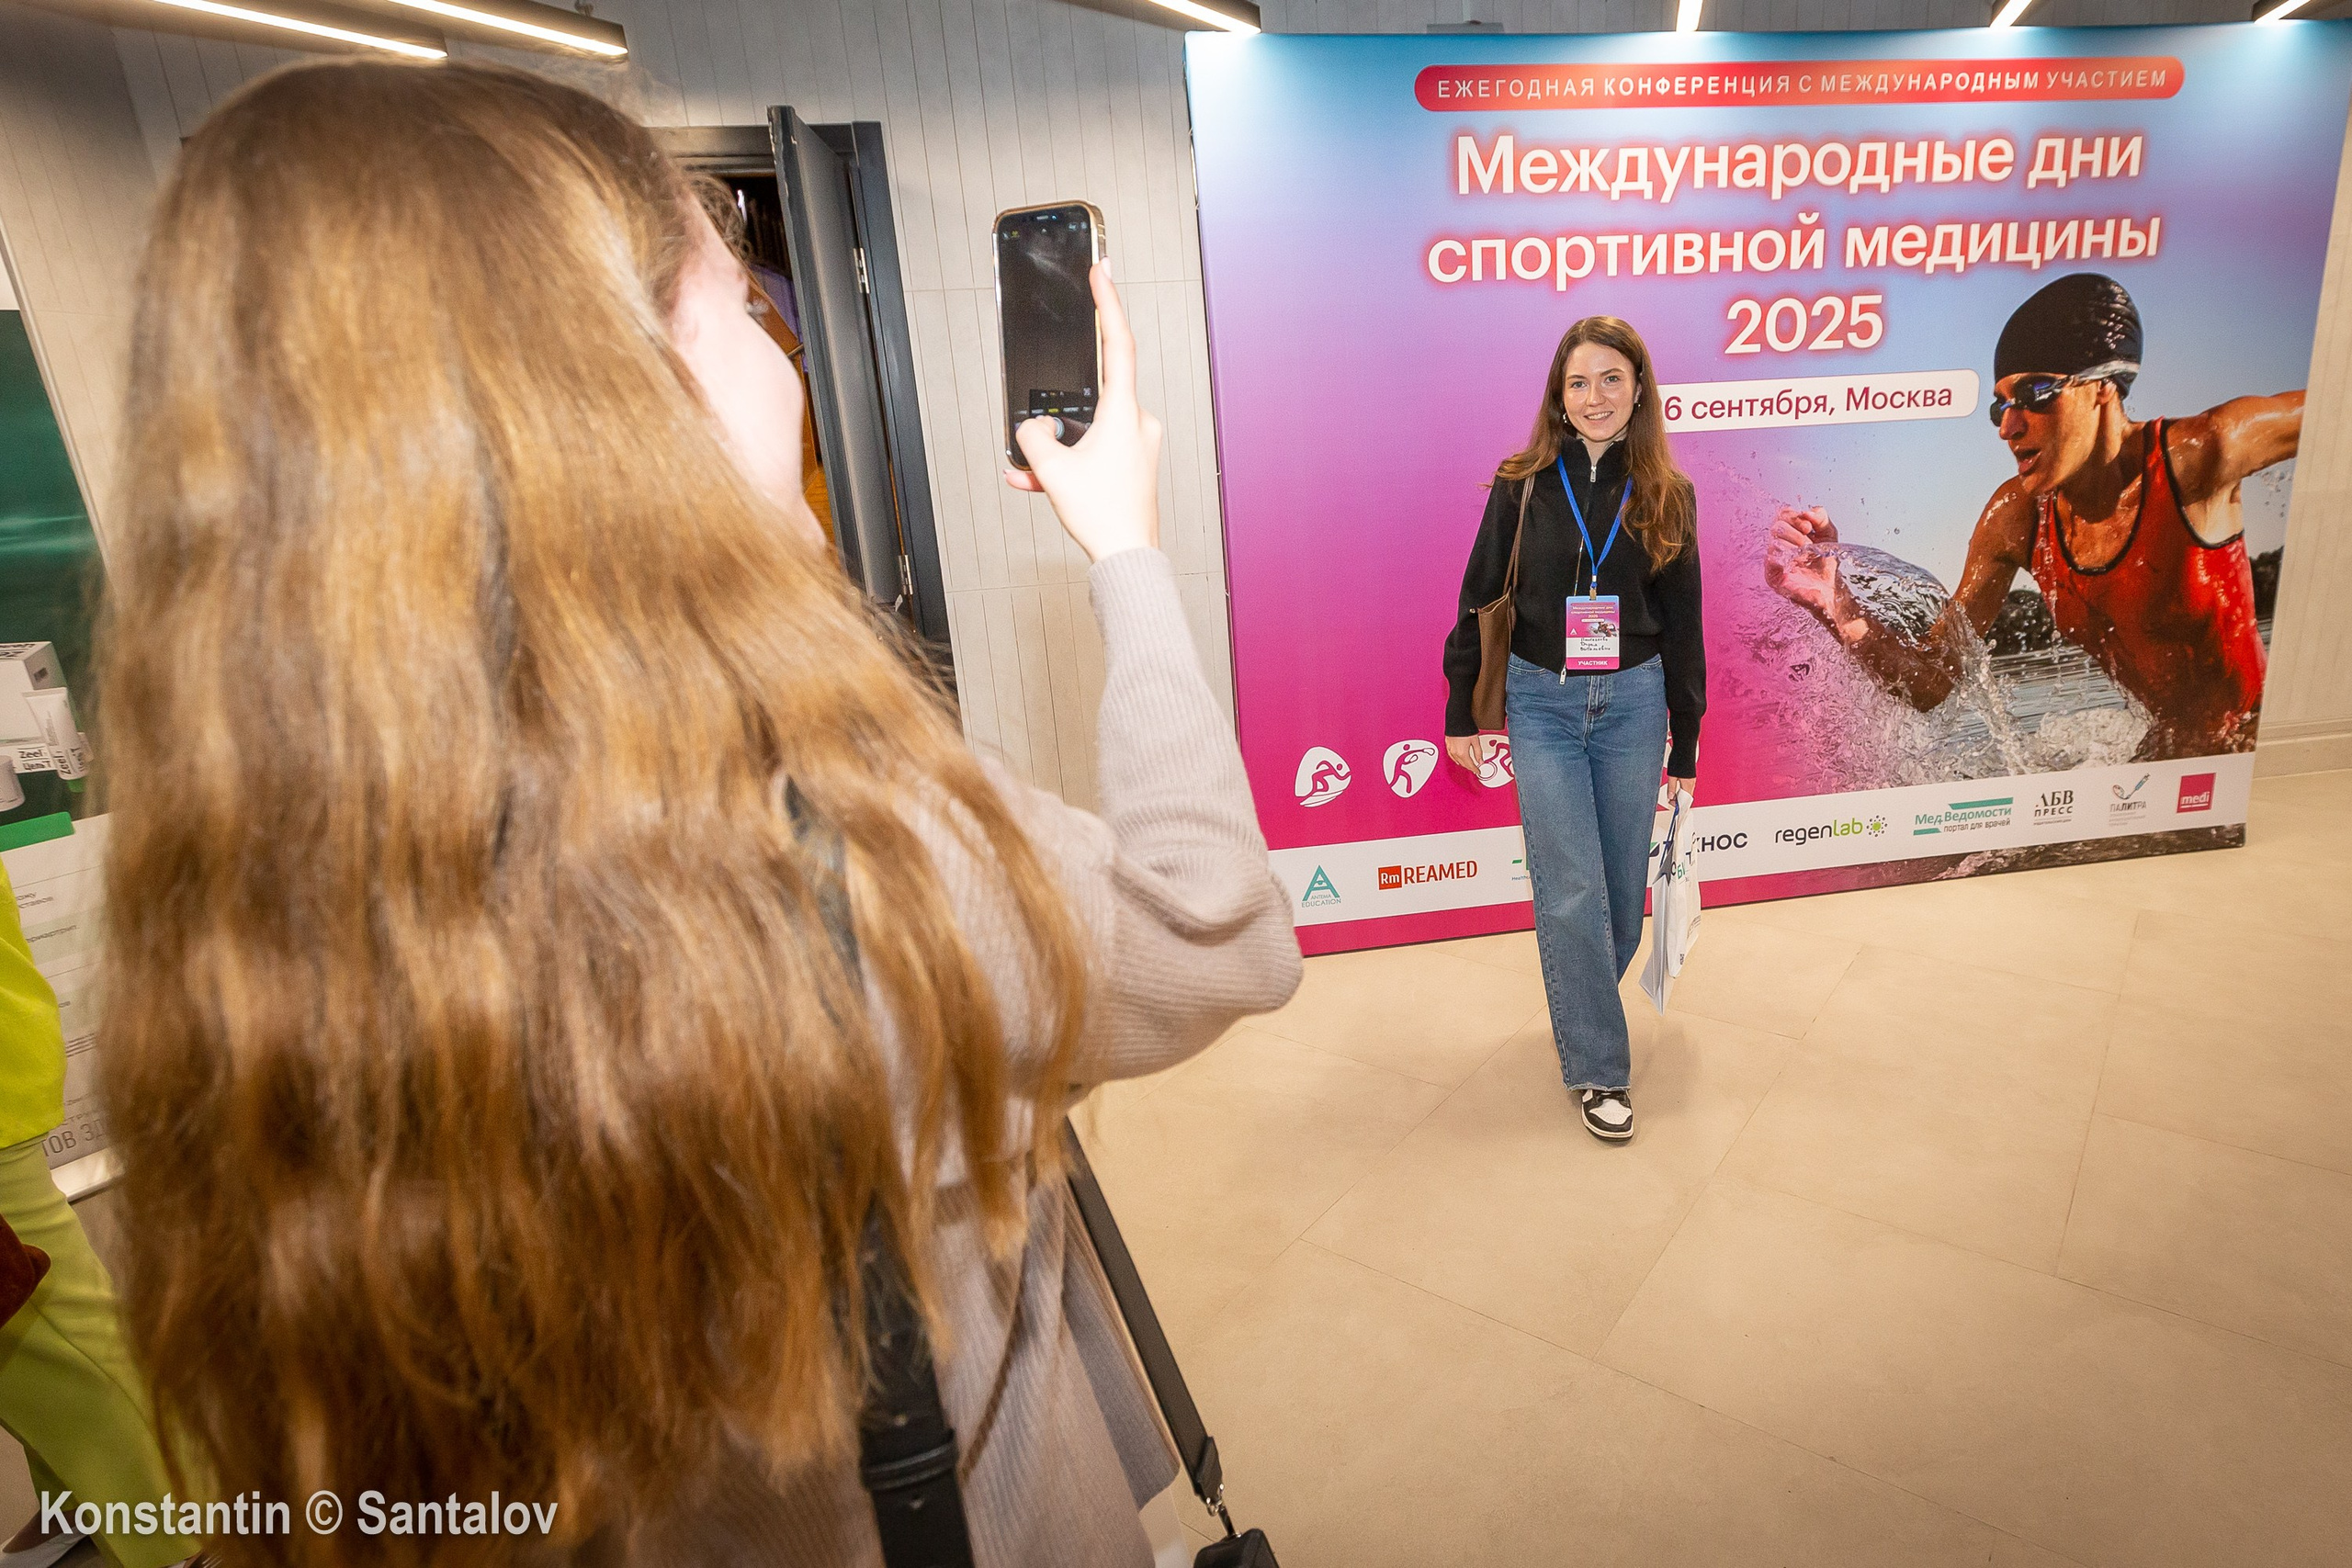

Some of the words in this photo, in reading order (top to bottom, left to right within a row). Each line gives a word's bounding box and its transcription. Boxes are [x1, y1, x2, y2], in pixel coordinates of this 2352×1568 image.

[1438, 78, 1594, 100] ЕЖЕГОДНАЯ
[1604, 75, 1791, 97] КОНФЕРЕНЦИЯ
[1798, 74, 1813, 93] С
[1820, 70, 2039, 95] МЕЖДУНАРОДНЫМ
[2046, 69, 2167, 90] УЧАСТИЕМ
[1457, 134, 2015, 203] Международные
[2028, 135, 2143, 189] дни
[1428, 212, 1826, 291] спортивной
[1845, 216, 2161, 275] медицины
[1724, 294, 1884, 355] 2025
[1690, 389, 1836, 420] сентября,
[1845, 386, 1953, 412] Москва
[2109, 801, 2147, 812] ПАЛИТРА
[2181, 791, 2211, 805] medi
[1943, 824, 1968, 833] портал
[1970, 822, 1983, 830] для
[1984, 818, 2011, 829] врачей
[2034, 806, 2074, 818] ПРЕСС
[1774, 818, 1864, 846] regenlab
[1403, 860, 1478, 886] REAMED
[1301, 898, 1341, 908] EDUCATION
